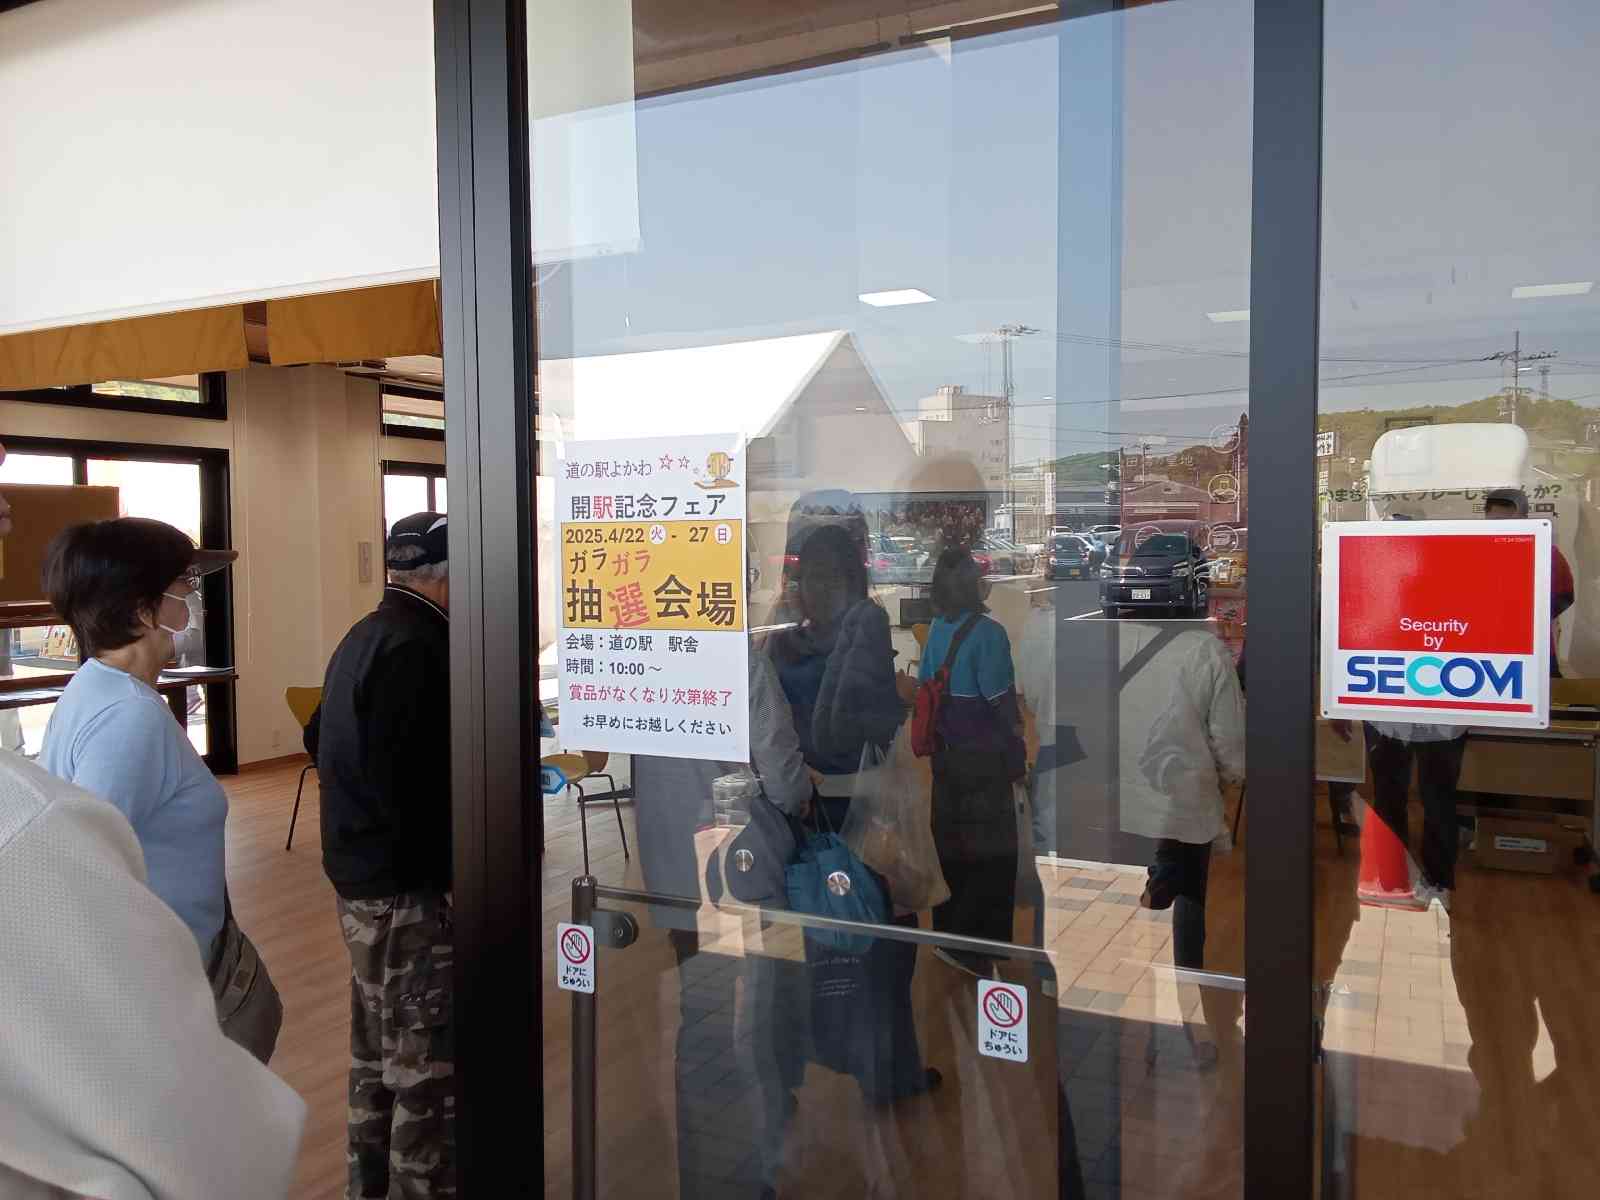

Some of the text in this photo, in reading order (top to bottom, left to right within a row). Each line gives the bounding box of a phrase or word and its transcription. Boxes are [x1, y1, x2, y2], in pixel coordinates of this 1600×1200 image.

[566, 460, 652, 479] 道の駅よかわ
[571, 493, 727, 520] 開駅記念フェア
[566, 527, 645, 544] 2025.4/22
[689, 526, 709, 543] 27
[570, 548, 652, 576] ガラガラ
[566, 574, 737, 629] 抽選会場
[1400, 617, 1470, 636] Security
[668, 636, 699, 653] 駅舎
[1424, 634, 1444, 650] by
[1347, 655, 1524, 700] SECOM
[569, 683, 733, 707] 賞品がなくなり次第終了
[582, 714, 732, 736] お早めにお越しください
[566, 965, 587, 976] ドアに
[562, 975, 590, 987] ちゅうい
[990, 1029, 1018, 1043] ドアに
[984, 1041, 1023, 1055] ちゅうい
